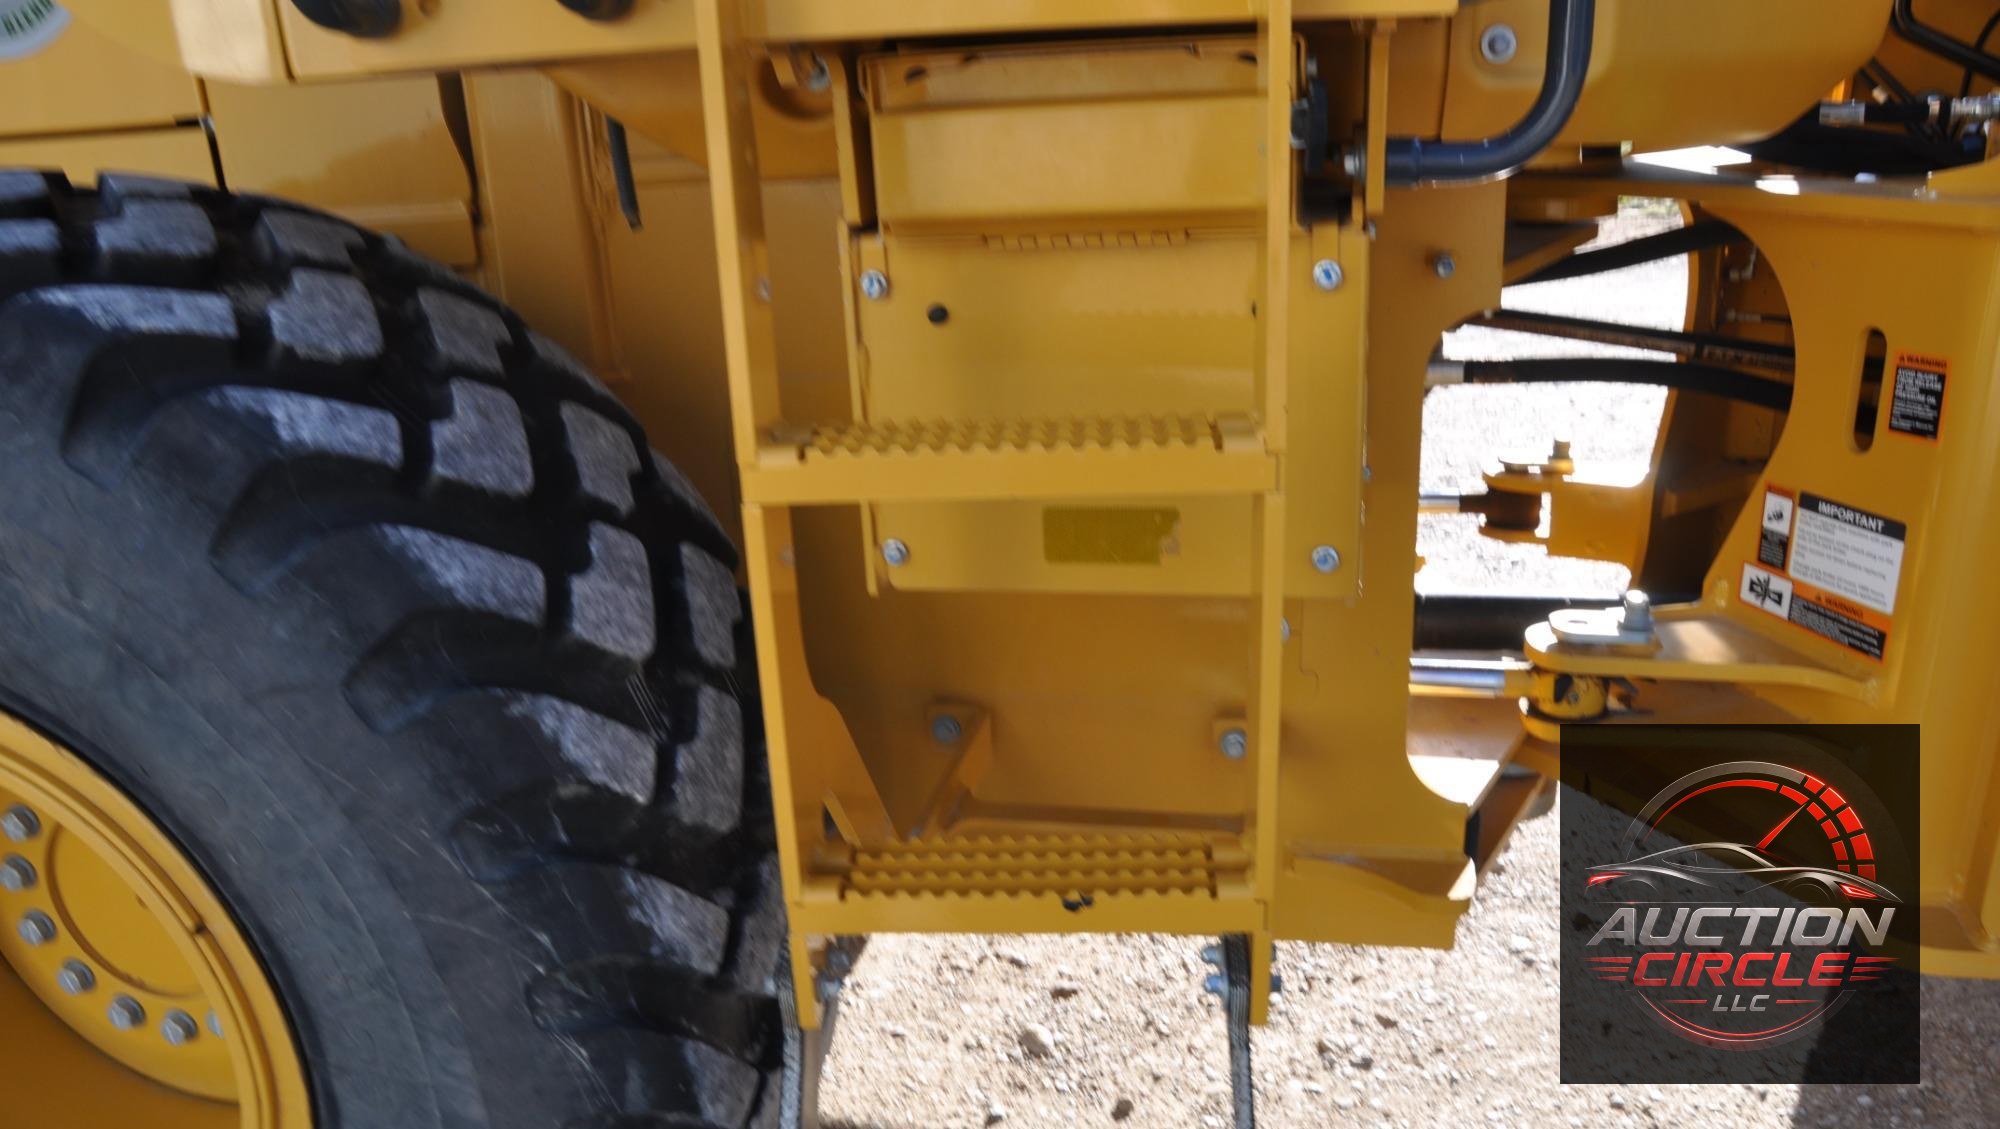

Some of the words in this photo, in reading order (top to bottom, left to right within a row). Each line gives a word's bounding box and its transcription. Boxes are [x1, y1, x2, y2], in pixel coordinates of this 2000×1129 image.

[1906, 356, 1947, 368] WARNING
[1818, 500, 1885, 532] IMPORTANT
[1825, 595, 1864, 618] WARNING
